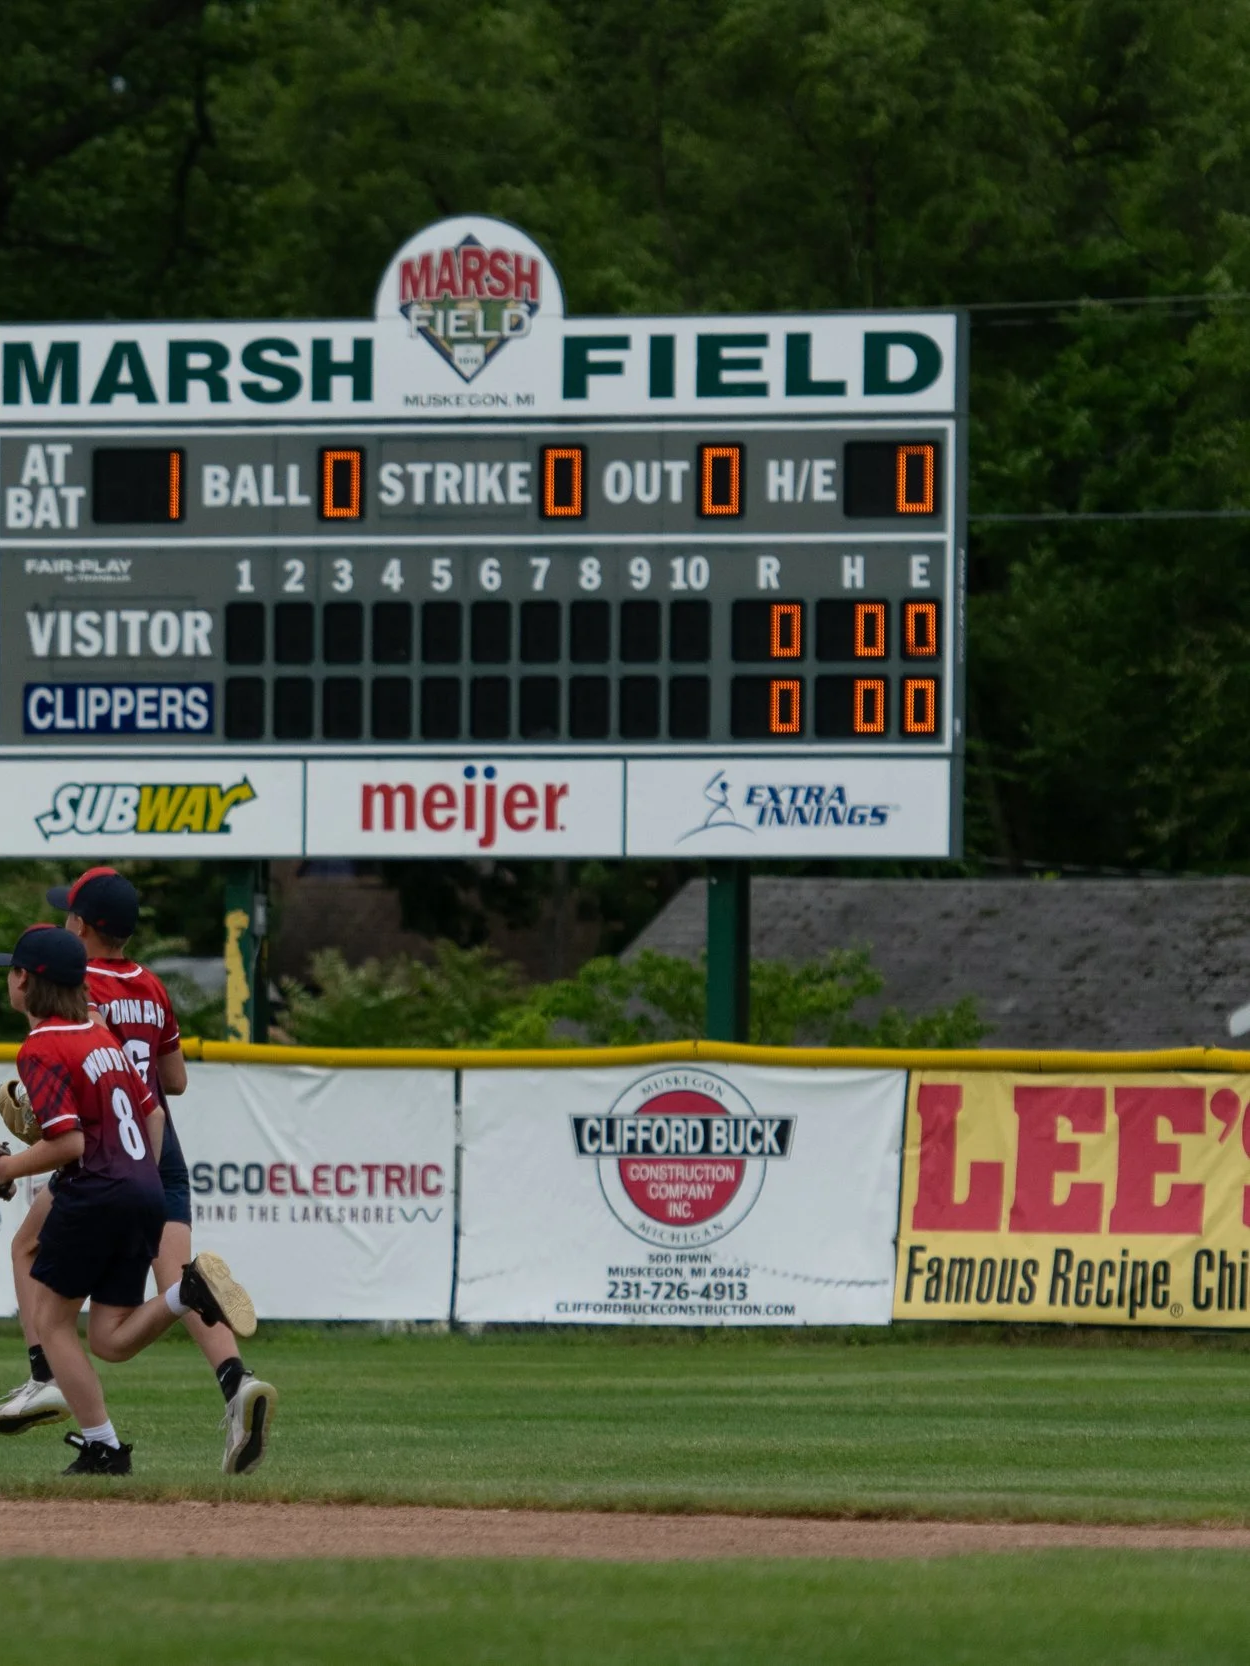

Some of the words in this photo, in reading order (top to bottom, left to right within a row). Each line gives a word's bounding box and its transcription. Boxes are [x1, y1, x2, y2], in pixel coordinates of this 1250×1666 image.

[400, 246, 540, 302] MARSH
[408, 305, 533, 339] FIELD
[2, 338, 373, 404] MARSH
[562, 331, 943, 399] FIELD
[404, 393, 512, 408] MUSKEGON,
[517, 393, 535, 406] MI
[21, 444, 72, 486] AT
[169, 452, 180, 520] 1
[202, 464, 310, 507] BALL
[323, 450, 360, 517] 0
[379, 462, 532, 505] STRIKE
[545, 448, 582, 516] 0
[603, 460, 690, 504] OUT
[702, 447, 740, 515] 0
[767, 459, 837, 503] H/E
[896, 445, 934, 513] 0
[6, 487, 87, 529] BAT
[237, 560, 255, 592] 1
[284, 559, 306, 592] 2
[332, 559, 354, 592] 3
[381, 559, 404, 592] 4
[431, 558, 452, 592] 5
[480, 558, 502, 591] 6
[529, 558, 550, 591] 7
[579, 557, 601, 591] 8
[629, 557, 651, 590] 9
[669, 556, 710, 591] 10
[757, 556, 781, 590] R
[842, 555, 865, 589] H
[910, 555, 931, 588] E
[26, 610, 213, 657] VISITOR
[770, 604, 801, 658] 0
[854, 603, 885, 656] 0
[905, 603, 936, 656] 0
[28, 687, 209, 730] CLIPPERS
[769, 680, 800, 733] 0
[854, 679, 885, 733] 0
[904, 679, 935, 733] 0
[35, 775, 257, 842] SUBWAY
[360, 764, 570, 849] meijer
[744, 784, 848, 805] EXTRA
[757, 805, 890, 827] INNINGS
[122, 1039, 150, 1085] 6
[641, 1075, 725, 1098] MUSKEGON
[111, 1087, 146, 1161] 8
[582, 1118, 705, 1154] CLIFFORD
[711, 1119, 782, 1155] BUCK
[192, 1161, 444, 1197] SCOELECTRIC
[628, 1164, 736, 1182] CONSTRUCTION
[912, 1084, 1250, 1235] LEE'
[649, 1183, 715, 1200] COMPANY
[667, 1201, 695, 1219] INC.
[196, 1204, 238, 1223] RING
[249, 1204, 280, 1223] THE
[291, 1204, 396, 1223] LAKESHORE
[638, 1222, 724, 1244] MICHIGAN
[607, 1266, 686, 1281] MUSKEGON,
[690, 1266, 707, 1278] MI
[676, 1253, 712, 1264] IRWIN
[904, 1245, 1040, 1306] Famous
[556, 1302, 796, 1317] CLIFFORDBUCKCONSTRUCTION.COM
[607, 1281, 748, 1301] 231-726-4913
